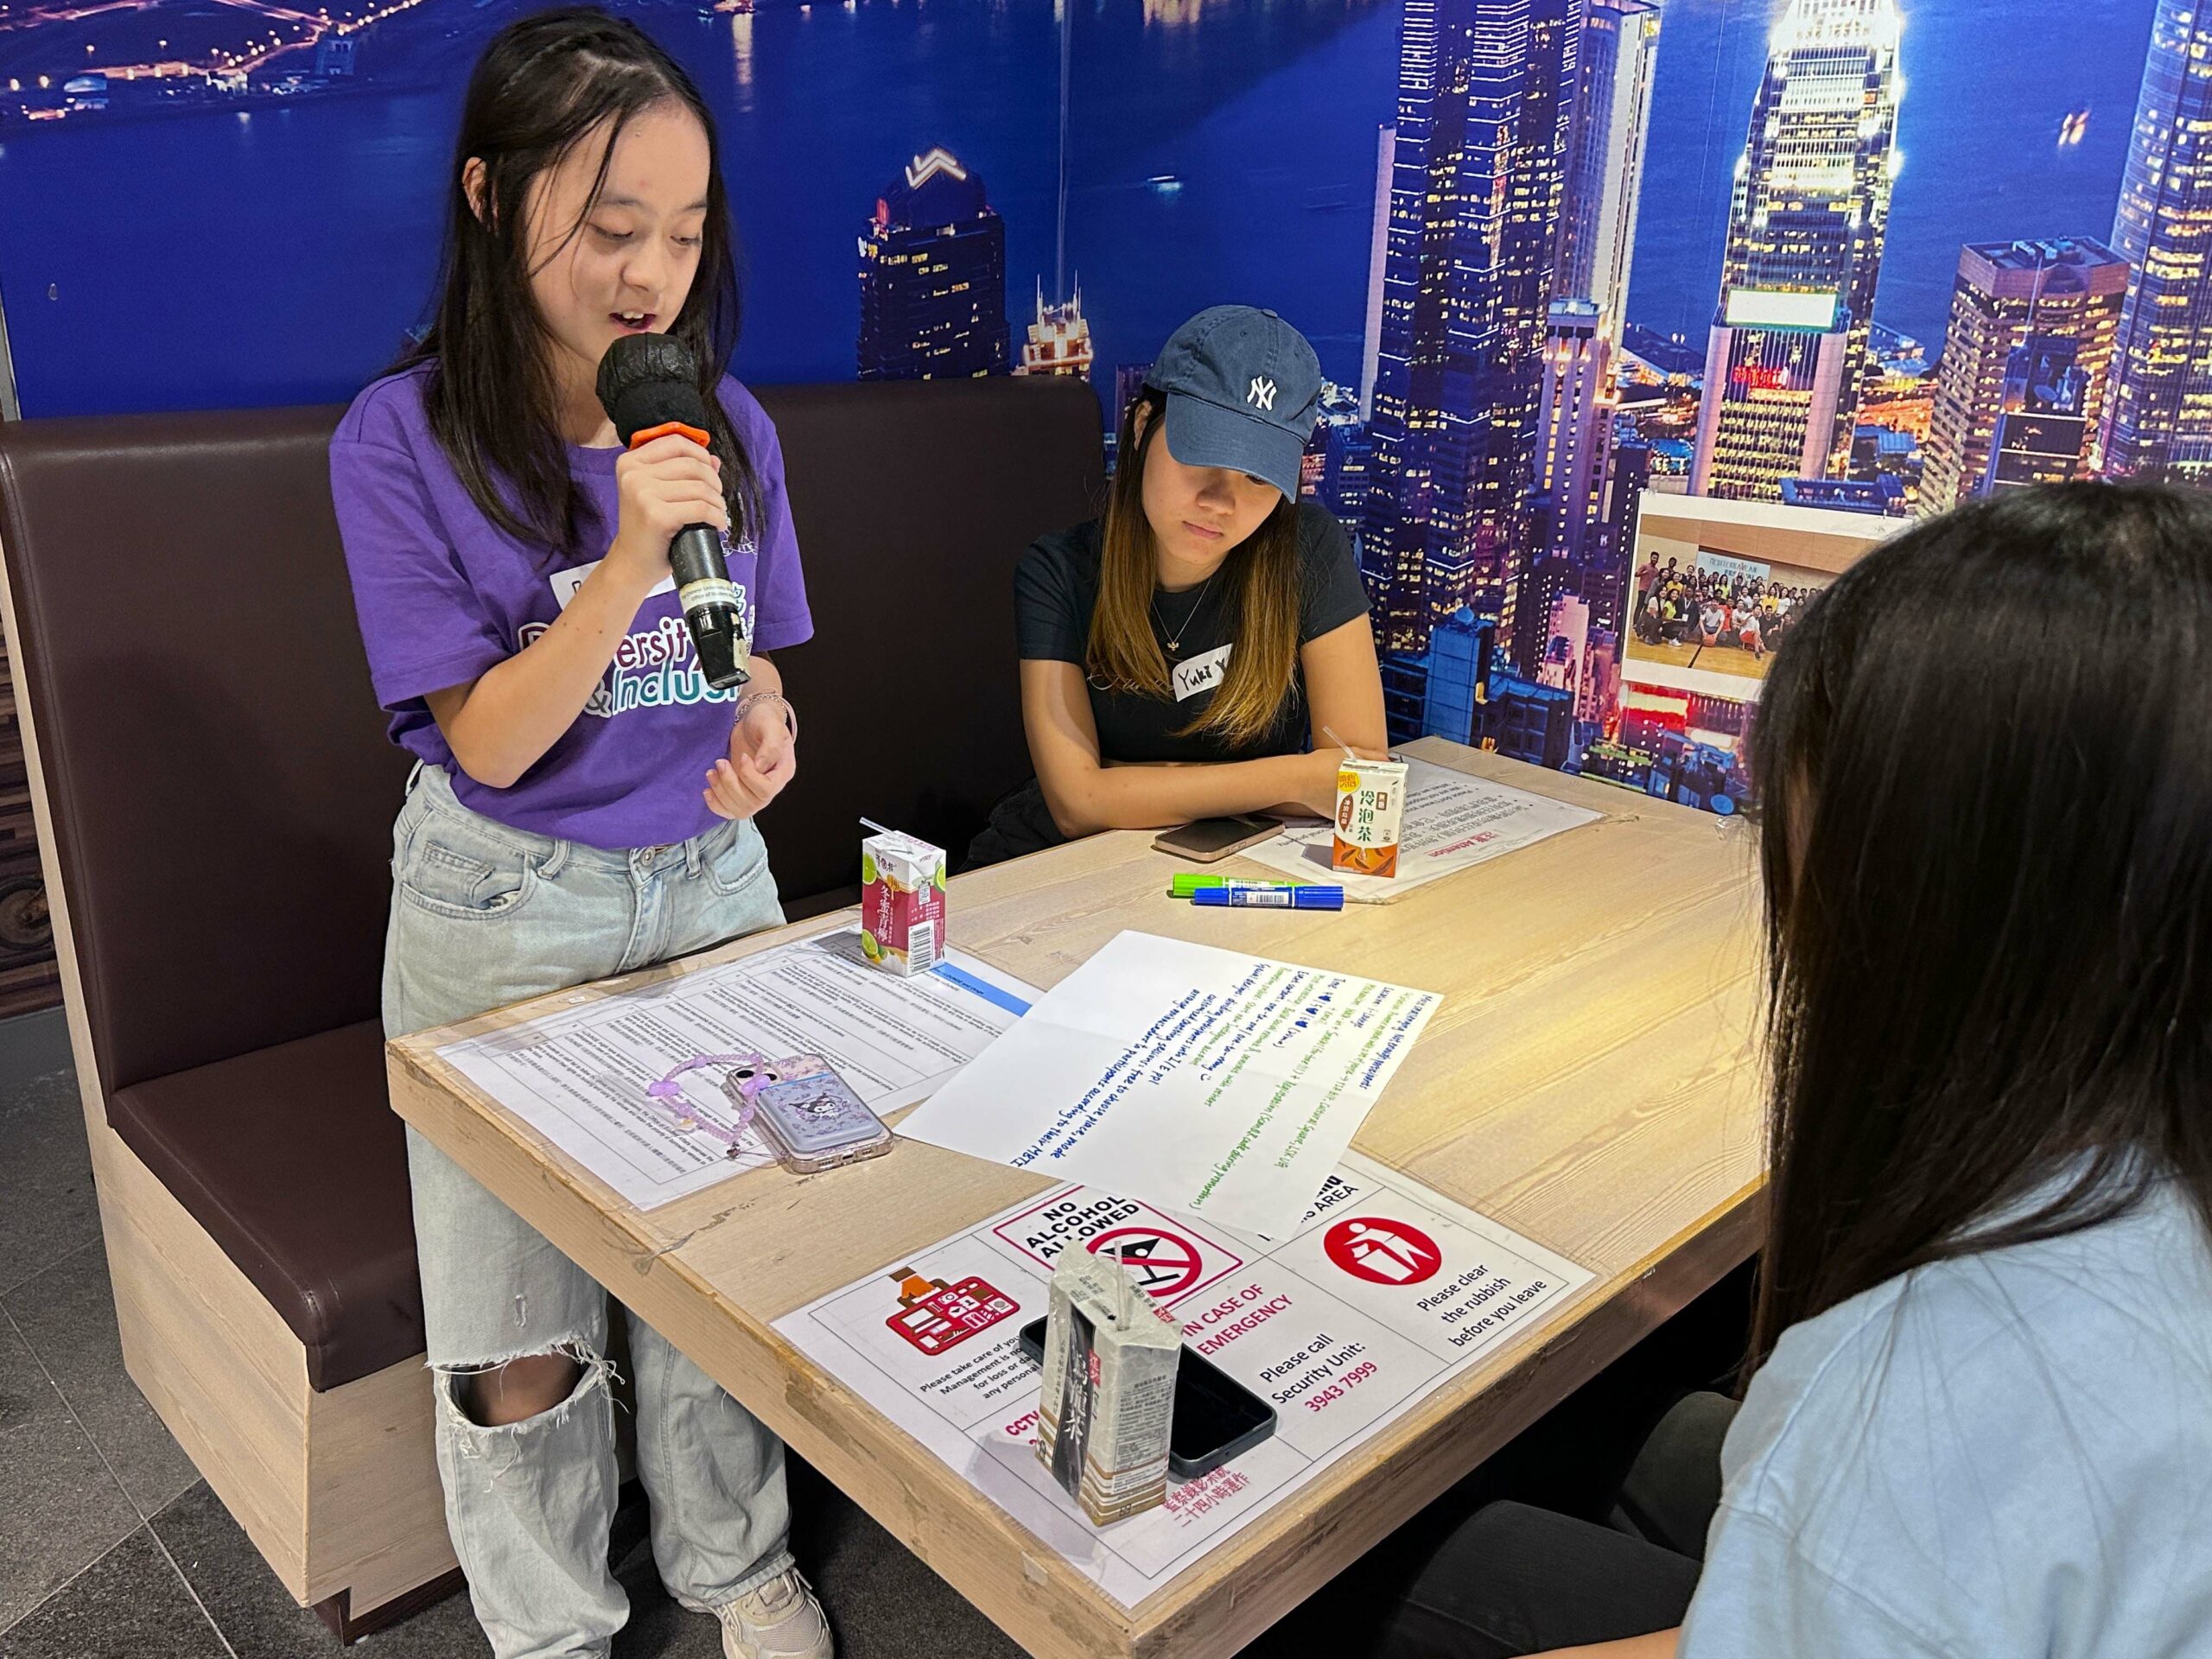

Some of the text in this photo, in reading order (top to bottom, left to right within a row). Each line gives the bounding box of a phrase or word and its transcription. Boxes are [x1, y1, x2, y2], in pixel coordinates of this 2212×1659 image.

[1357, 790, 1376, 842] 冷泡茶
[1428, 841, 1476, 857] Attention
[1123, 1069, 1143, 1084] free
[1148, 1071, 1163, 1085] ppl
[1059, 1088, 1101, 1119] according
[1093, 1094, 1119, 1116] choose
[1038, 1128, 1061, 1147] their
[1071, 1115, 1097, 1135] place,
[1010, 1145, 1043, 1166] MBTI
[1050, 1137, 1077, 1159] mode
[1042, 1202, 1077, 1221] NO
[1314, 1185, 1359, 1211] AREA
[1027, 1196, 1127, 1249] ALCOHOL
[1417, 1265, 1488, 1311] Please clear
[1441, 1279, 1510, 1323] the rubbish
[1181, 1284, 1262, 1337] IN CASE OF
[1198, 1294, 1292, 1355] EMERGENCY
[1448, 1281, 1547, 1346] before you leave
[920, 1375, 951, 1392] Please
[951, 1363, 972, 1375] take
[973, 1351, 993, 1363] care
[988, 1344, 1003, 1355] of
[1260, 1334, 1333, 1382] Please call
[1272, 1343, 1365, 1403] Security Unit:
[940, 1365, 991, 1394] Management
[987, 1360, 1001, 1369] is
[974, 1380, 988, 1389] for
[988, 1370, 1007, 1381] loss
[983, 1364, 1039, 1398] any personal
[1305, 1362, 1376, 1412] 3943 7999
[1180, 1472, 1250, 1526] 二十四小時運作
